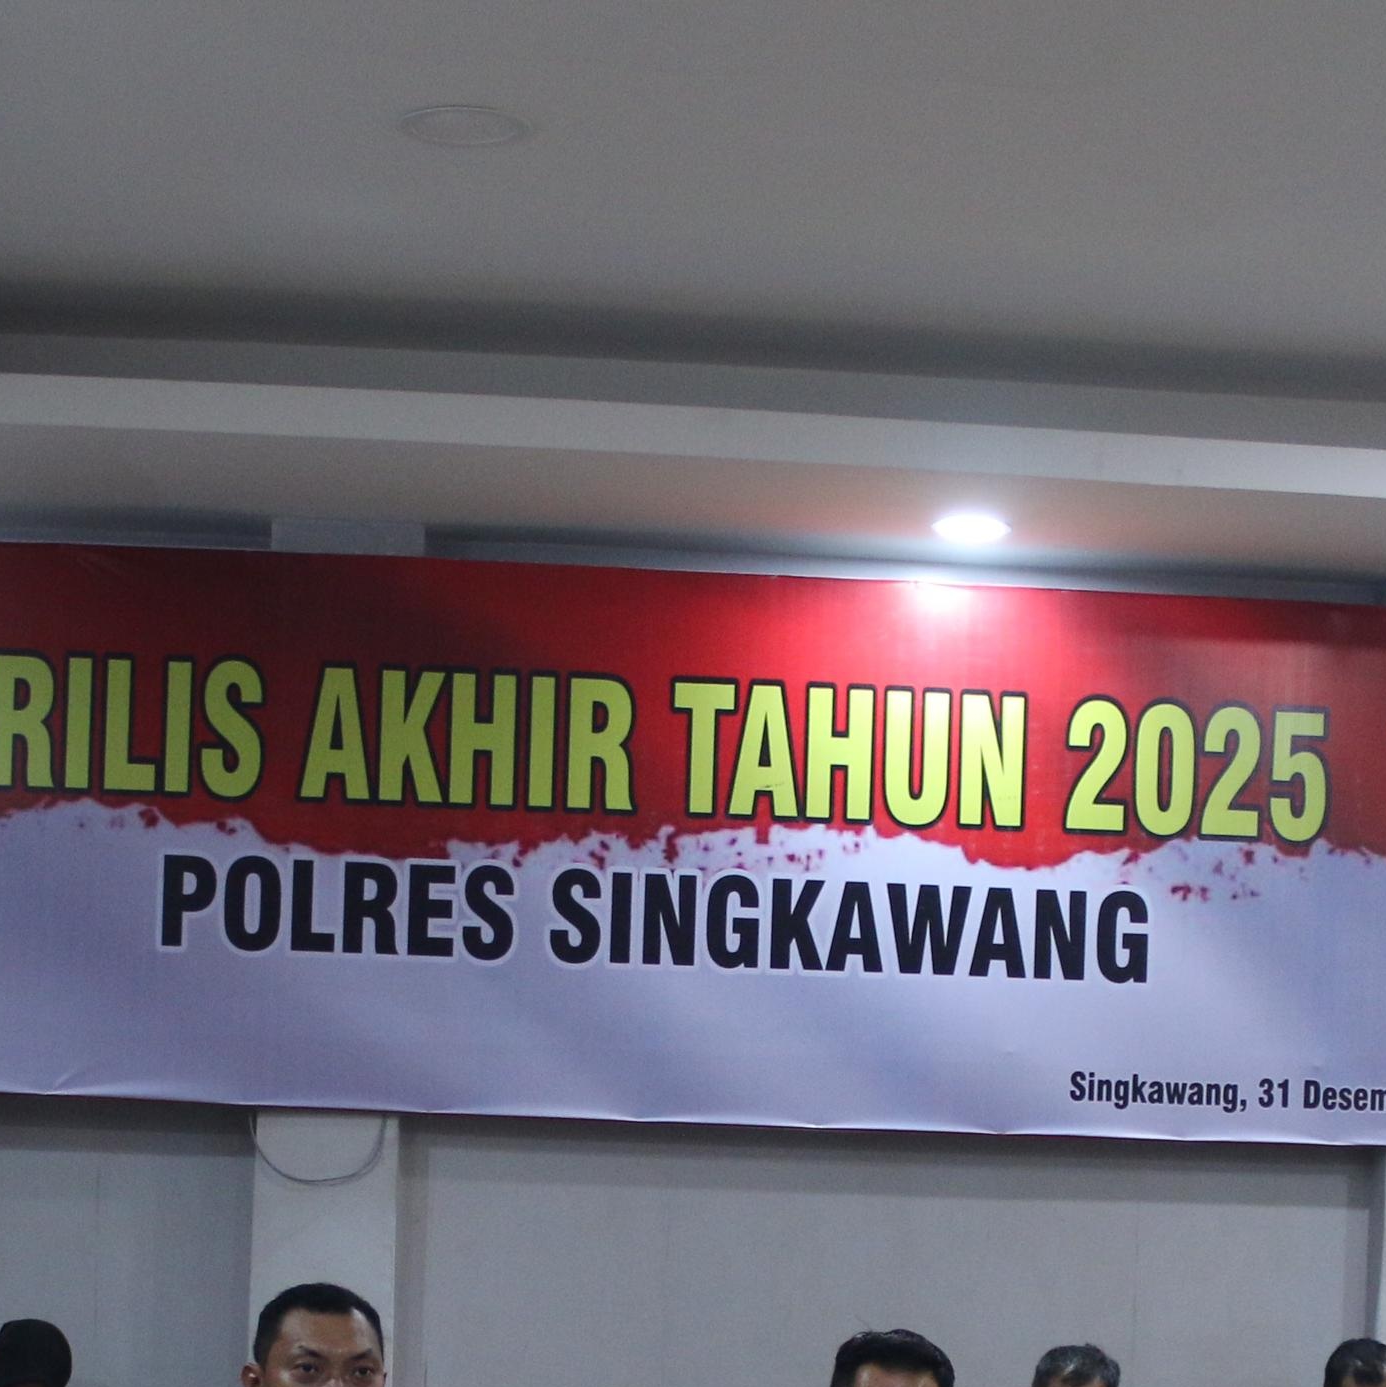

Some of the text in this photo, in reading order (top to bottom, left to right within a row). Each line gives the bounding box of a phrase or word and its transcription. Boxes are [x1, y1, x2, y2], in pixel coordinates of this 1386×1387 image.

[297, 665, 635, 812] AKHIR
[670, 680, 1027, 829] TAHUN
[1064, 699, 1328, 843] 2025
[160, 853, 1149, 984] POLRES SINGKAWANG
[1069, 1071, 1248, 1113] Singkawang,
[1258, 1078, 1289, 1108] 31
